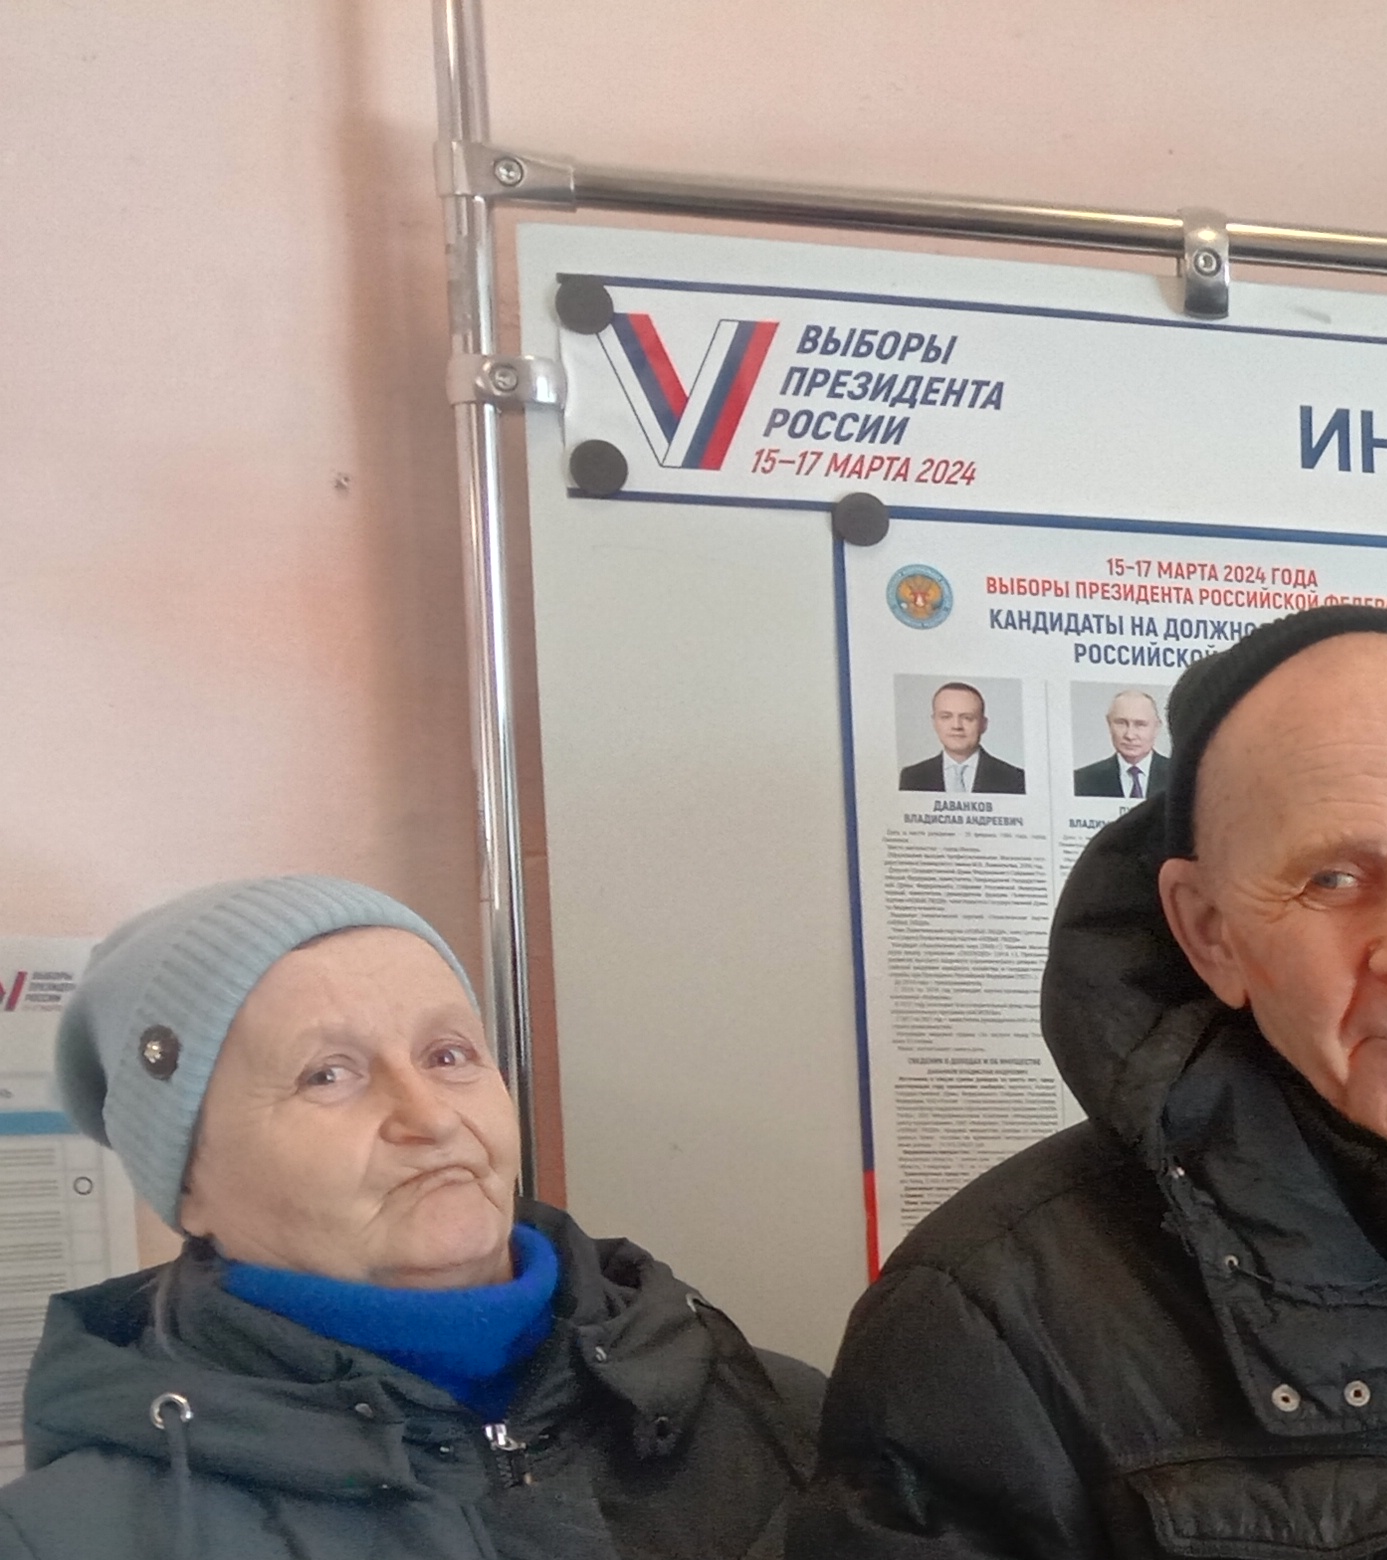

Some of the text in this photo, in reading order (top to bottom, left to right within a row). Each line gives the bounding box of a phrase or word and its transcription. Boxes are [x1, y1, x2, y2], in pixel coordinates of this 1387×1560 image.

[796, 324, 958, 365] ВЫБОРЫ
[779, 366, 1005, 411] ПРЕЗИДЕНТА
[762, 408, 911, 446] РОССИИ
[824, 452, 911, 482] МАРТА
[915, 458, 977, 486] 2024
[1157, 561, 1219, 582] МАРТА
[1223, 564, 1266, 585] 2024
[1271, 567, 1318, 590] ГОДА
[986, 576, 1070, 599] ВЫБОРЫ
[1076, 581, 1195, 606] ПРЕЗИДЕНТА
[1199, 586, 1319, 611] РОССИЙСКОЙ
[989, 608, 1257, 642] КАНДИДАТЫ НА ДОЛЖНО
[933, 800, 993, 813] ДАВАНКОВ
